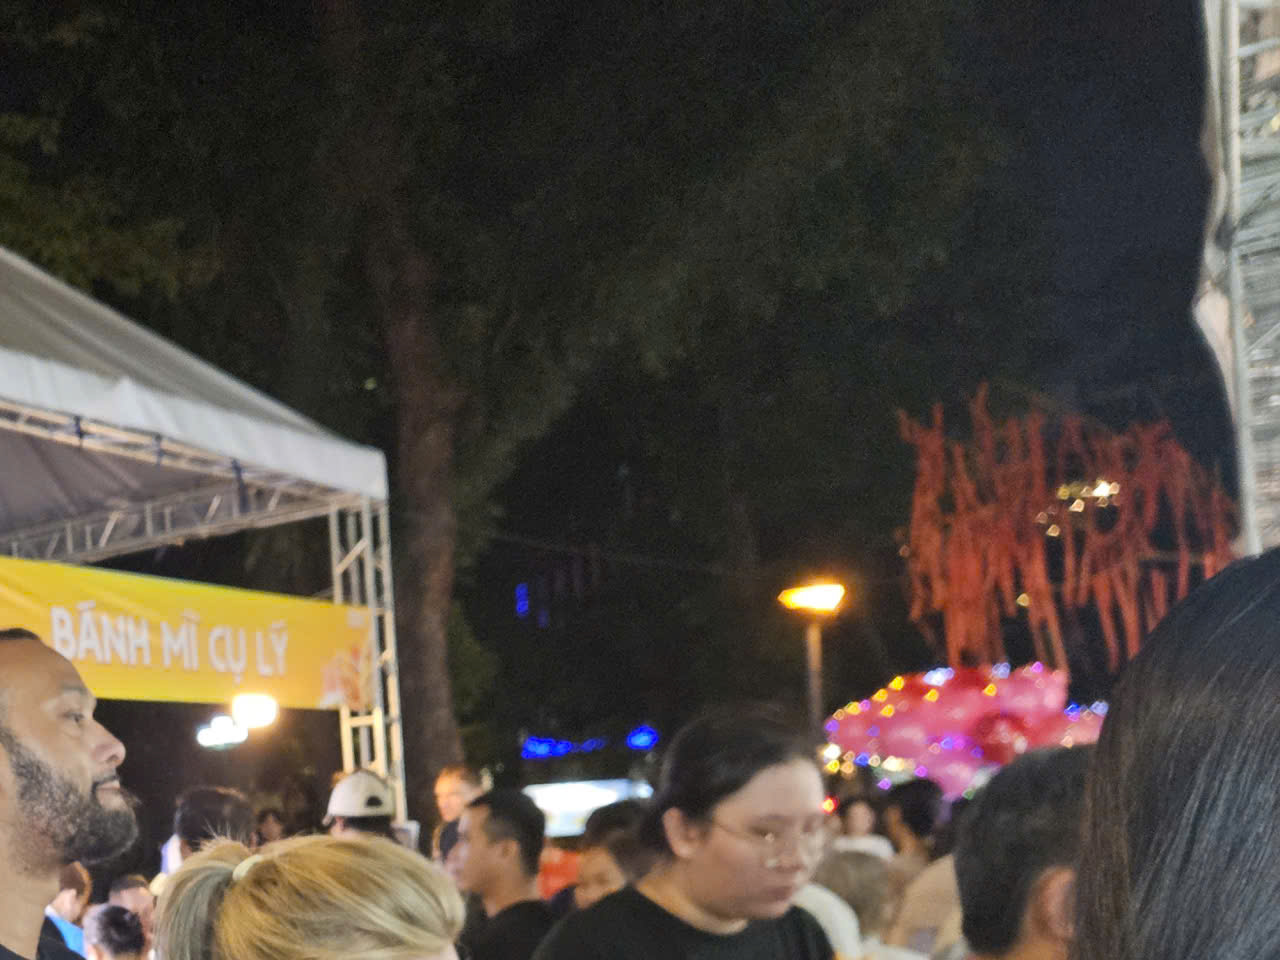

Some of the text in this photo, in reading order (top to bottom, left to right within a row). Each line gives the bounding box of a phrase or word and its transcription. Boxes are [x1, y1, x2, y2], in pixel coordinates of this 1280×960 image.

[50, 601, 151, 666] BÁNH
[160, 608, 199, 671] MÌ
[208, 626, 247, 685] CỤ
